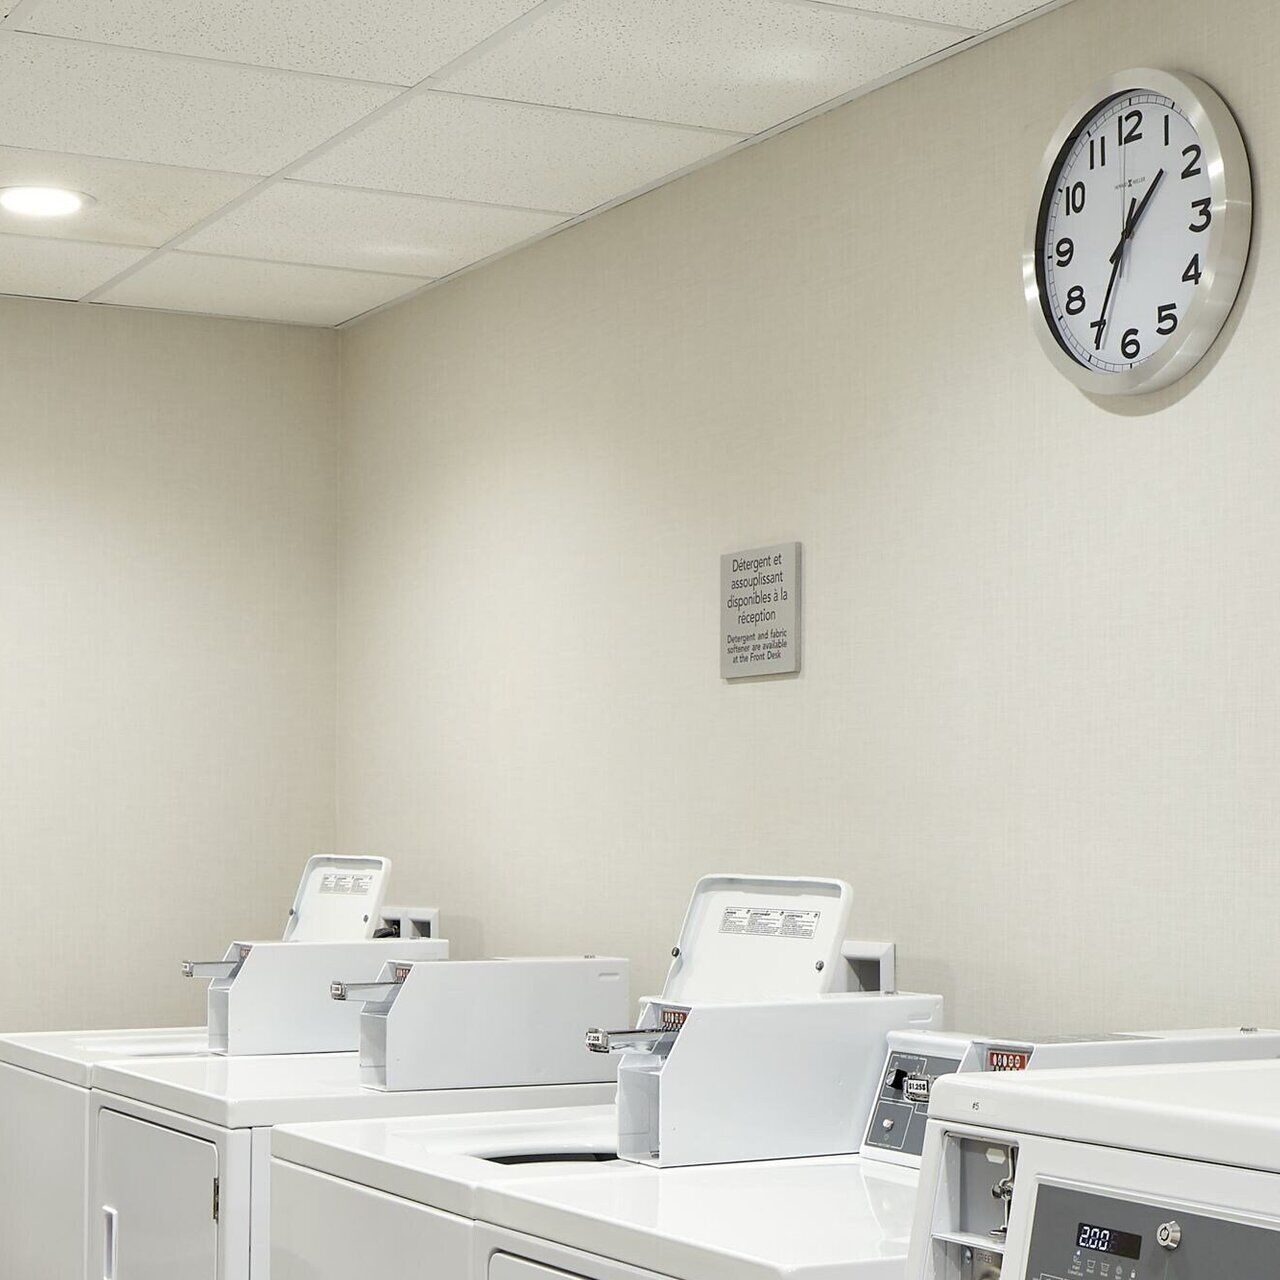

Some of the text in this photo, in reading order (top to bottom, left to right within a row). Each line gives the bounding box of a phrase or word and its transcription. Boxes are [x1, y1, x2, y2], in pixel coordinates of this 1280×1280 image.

[1118, 109, 1143, 145] 12
[1164, 115, 1169, 146] 1
[1089, 136, 1106, 169] 11
[1181, 144, 1202, 180] 2
[1065, 181, 1085, 216] 10
[1189, 198, 1211, 233] 3
[1056, 237, 1074, 268] 9
[1182, 253, 1202, 285] 4
[1066, 286, 1086, 315] 8
[1090, 319, 1107, 350] 7
[1157, 303, 1178, 335] 5
[1120, 328, 1141, 359] 6
[732, 553, 781, 572] Détergent et
[731, 572, 783, 591] assouplissant
[727, 587, 788, 611] disponibles à la
[738, 608, 776, 627] réception
[1079, 1226, 1109, 1250] 2.00
